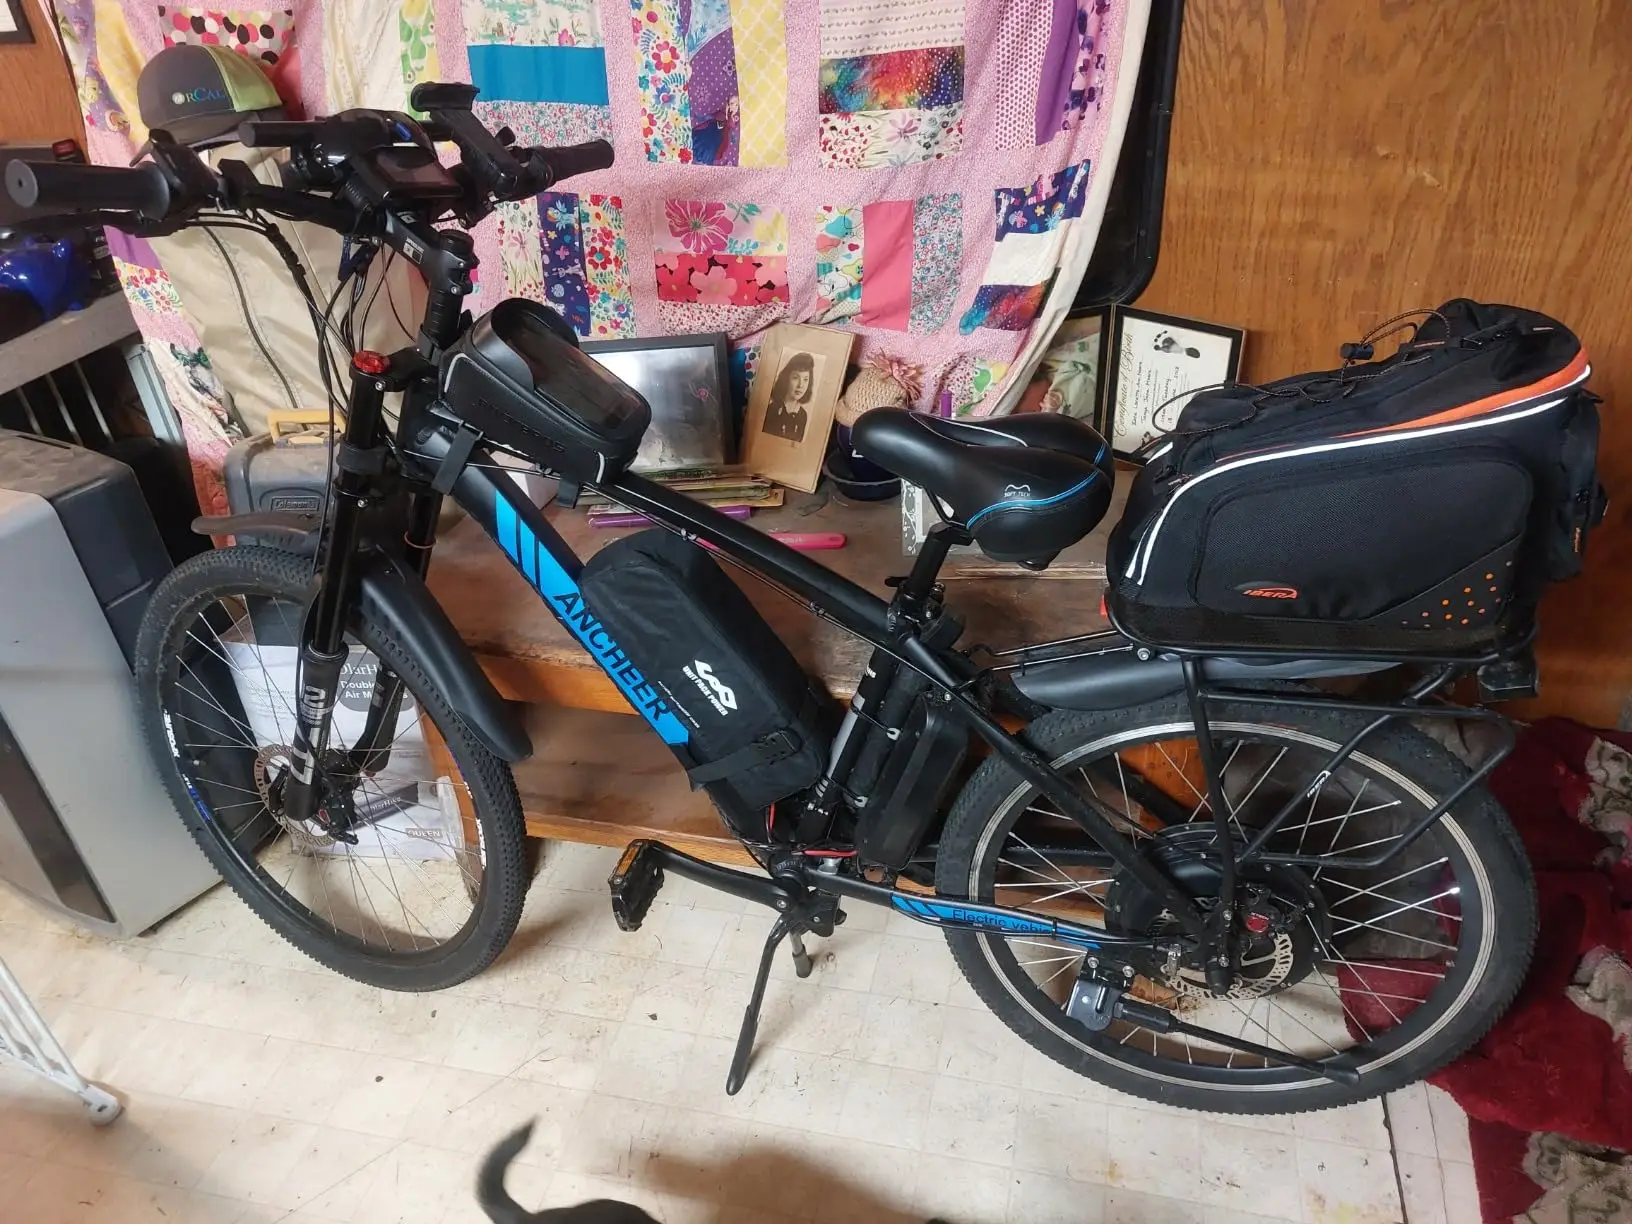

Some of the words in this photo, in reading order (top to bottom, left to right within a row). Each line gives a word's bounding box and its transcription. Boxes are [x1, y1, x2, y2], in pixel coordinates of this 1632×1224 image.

[1121, 333, 1134, 372] Birth
[1113, 382, 1131, 437] Certificate
[1242, 587, 1298, 599] IBERA
[553, 592, 672, 721] ANCHEER
[345, 690, 360, 699] Air
[682, 665, 698, 681] UNIT
[694, 678, 712, 697] PACK
[707, 694, 729, 717] POWER
[407, 829, 441, 838] QUEEN
[952, 909, 1007, 927] Electric
